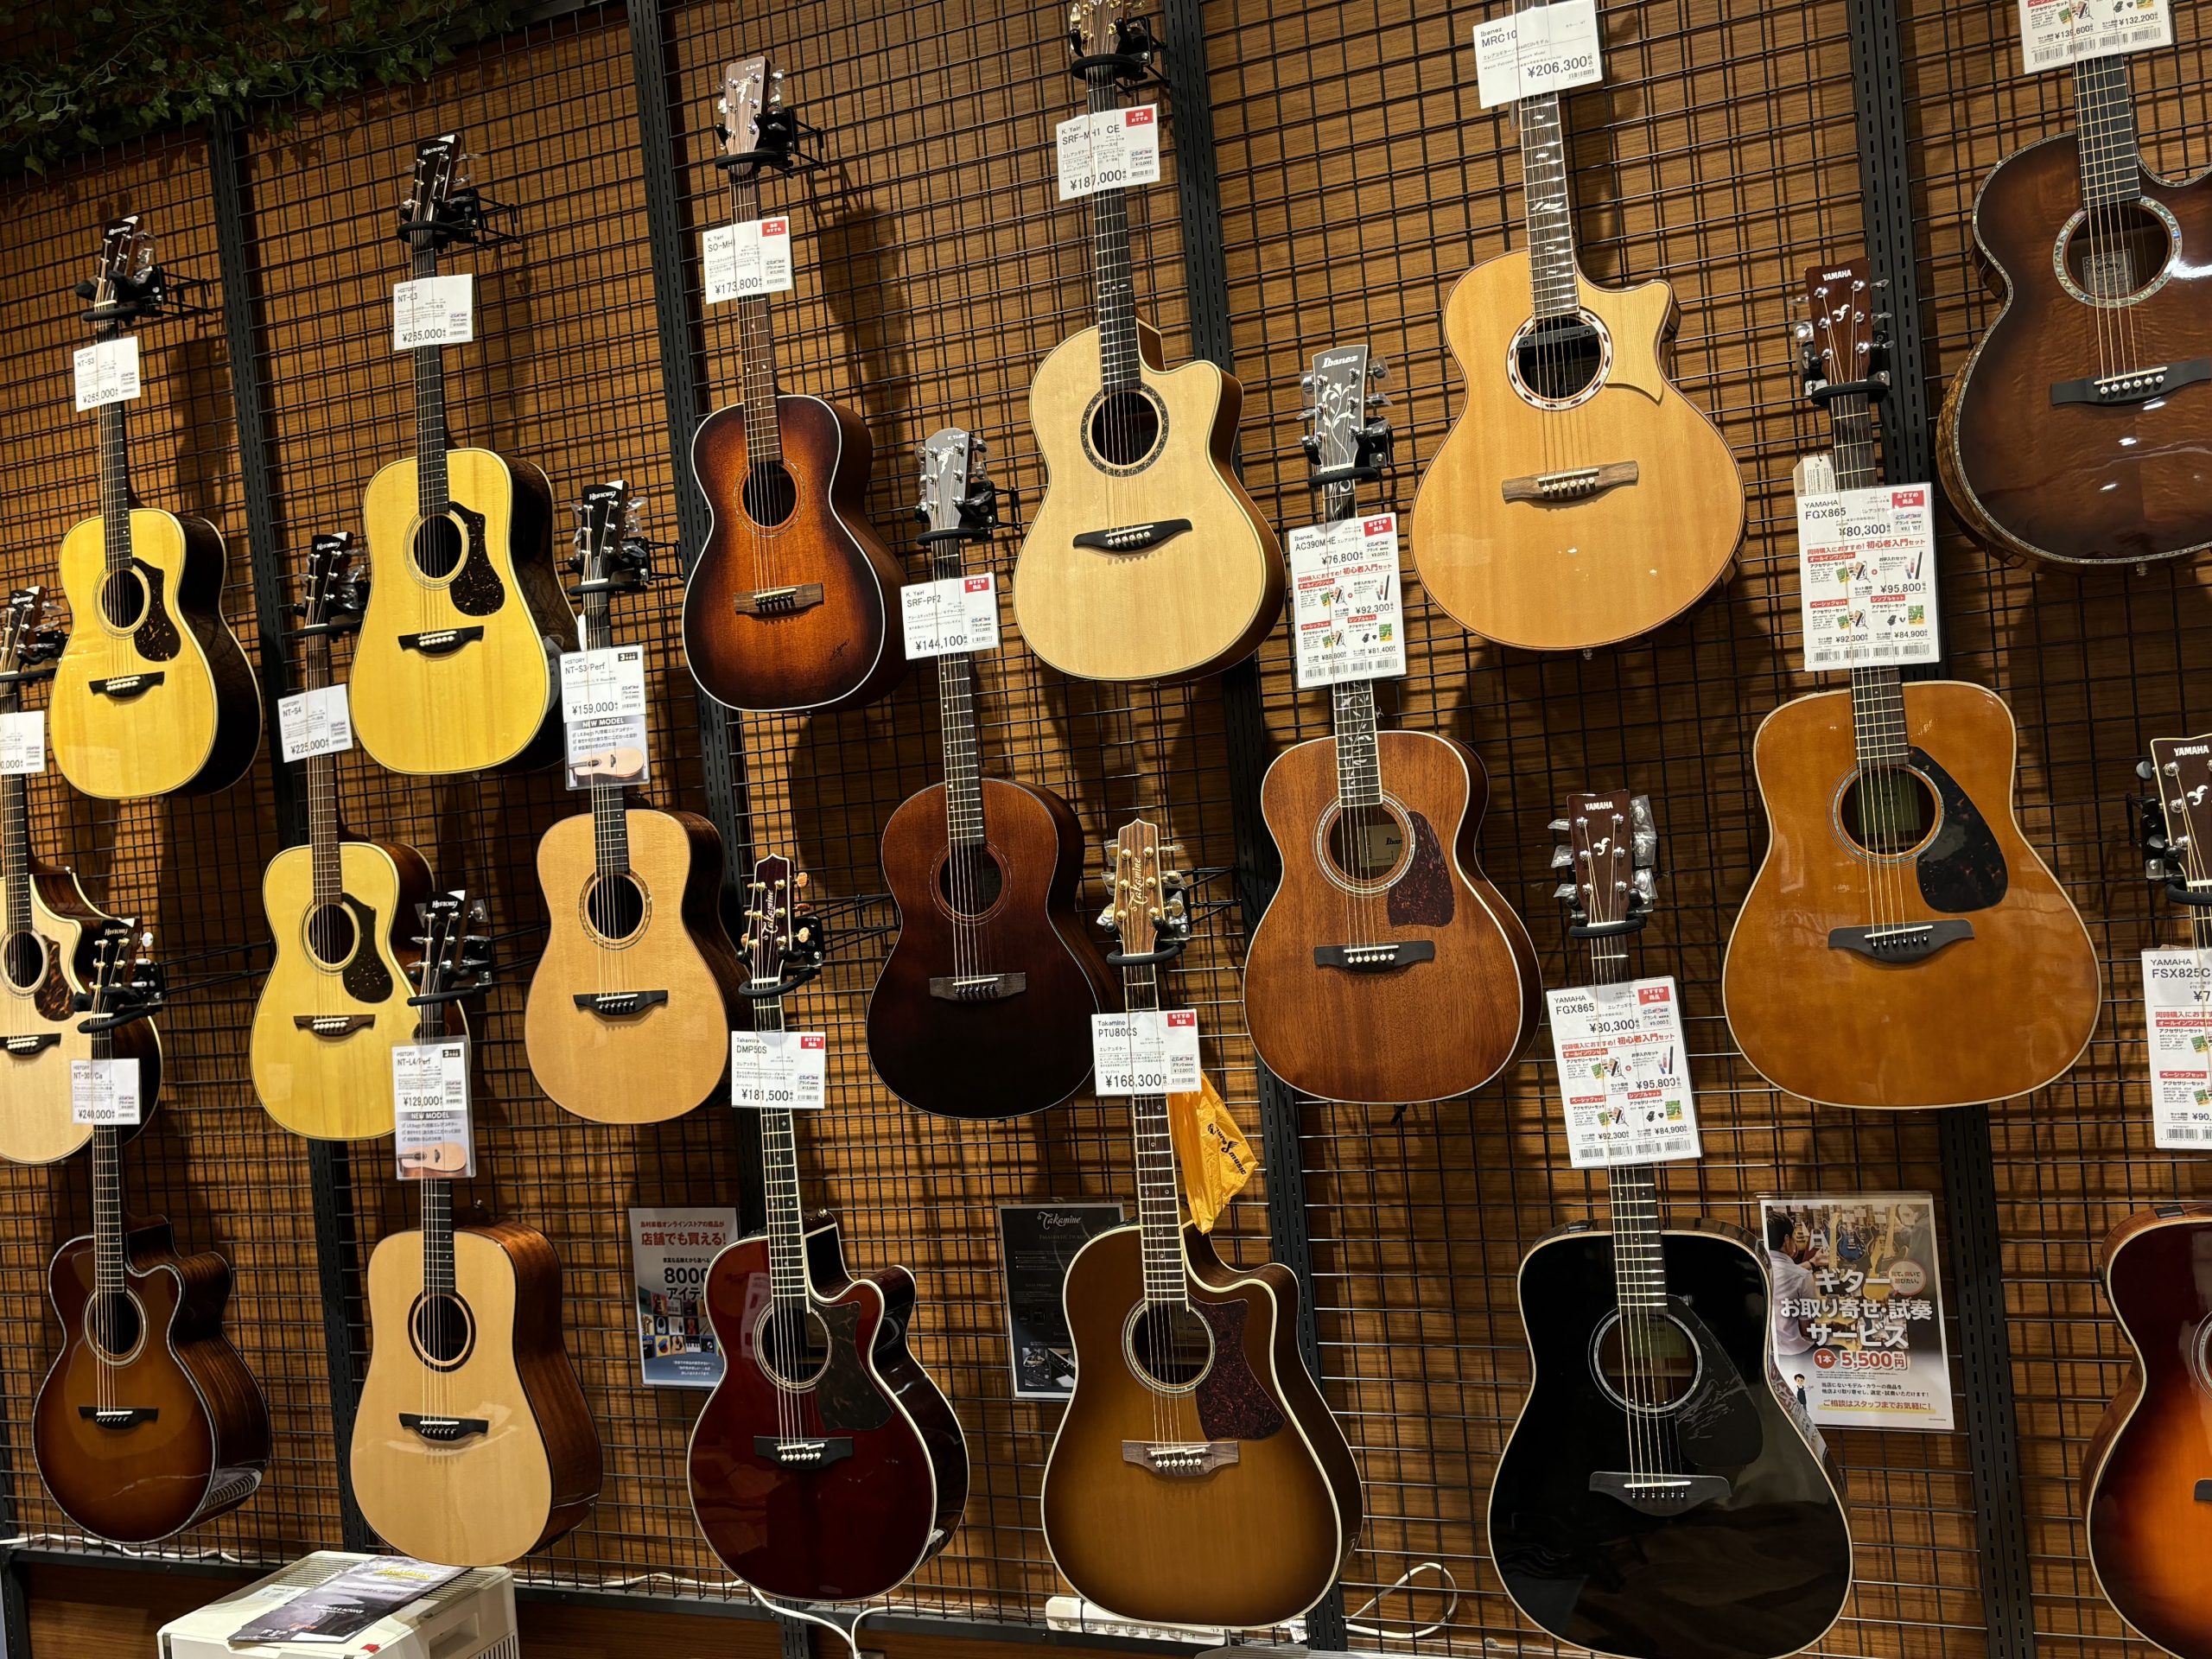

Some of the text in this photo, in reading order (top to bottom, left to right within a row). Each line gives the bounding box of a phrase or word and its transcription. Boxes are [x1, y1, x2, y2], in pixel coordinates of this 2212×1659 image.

[2119, 14, 2155, 26] ¥132,200
[1481, 28, 1503, 37] Ibanez
[1482, 30, 1517, 48] MRC10
[2056, 25, 2090, 40] ¥139,600
[1528, 55, 1587, 79] ¥206,300
[1107, 124, 1120, 133] CE
[1071, 170, 1122, 190] ¥187,000
[709, 239, 734, 251] SO-MH
[1822, 270, 1852, 281] YAMAHA
[715, 277, 758, 295] ¥173,800
[398, 293, 417, 302] NT-L3
[403, 328, 442, 342] ¥265,000
[1322, 355, 1358, 368] Ibanez
[589, 491, 616, 500] HISTORY
[1806, 508, 1846, 519] FGX865
[1840, 524, 1886, 537] ¥80,300
[1866, 538, 1925, 548] 初心者入門セット
[1322, 552, 1358, 565] ¥76,800
[1880, 583, 1921, 593] ¥95,800
[1356, 603, 1389, 614] ¥92,300
[1836, 634, 1865, 643] ¥92,300
[1895, 630, 1925, 639] ¥84,900
[916, 635, 963, 651] ¥144,100
[573, 702, 613, 715] ¥159,000
[599, 717, 624, 726] MODEL
[291, 739, 326, 754] ¥225,000
[2174, 745, 2209, 756] YAMAHA
[1585, 801, 1613, 810] YAMAHA
[1128, 857, 1147, 912] Takamine
[2152, 968, 2210, 978] FSX825C
[1554, 995, 1586, 1004] YAMAHA
[1556, 1003, 1594, 1015] FGX865
[1590, 1020, 1635, 1033] ¥80,300
[1618, 1033, 1675, 1045] 初心者入門セット
[736, 1046, 766, 1054] DMP50S
[1106, 1074, 1161, 1088] ¥168,300
[1637, 1077, 1675, 1090] ¥95,800
[742, 1089, 789, 1102] ¥181,500
[1655, 1126, 1684, 1135] ¥84,900
[1037, 1211, 1081, 1230] Takamine
[642, 1232, 726, 1245] 店舗でも買える!
[1815, 1268, 1891, 1294] ギター
[666, 1287, 705, 1300] アイテ
[1780, 1298, 1933, 1319] お取り寄せ・試奏
[1807, 1324, 1909, 1348] サービス
[1817, 1355, 1832, 1363] 1本
[1841, 1352, 1892, 1369] 5,500
[1823, 1400, 1931, 1410] ご相談はスタッフまでお気軽に!
